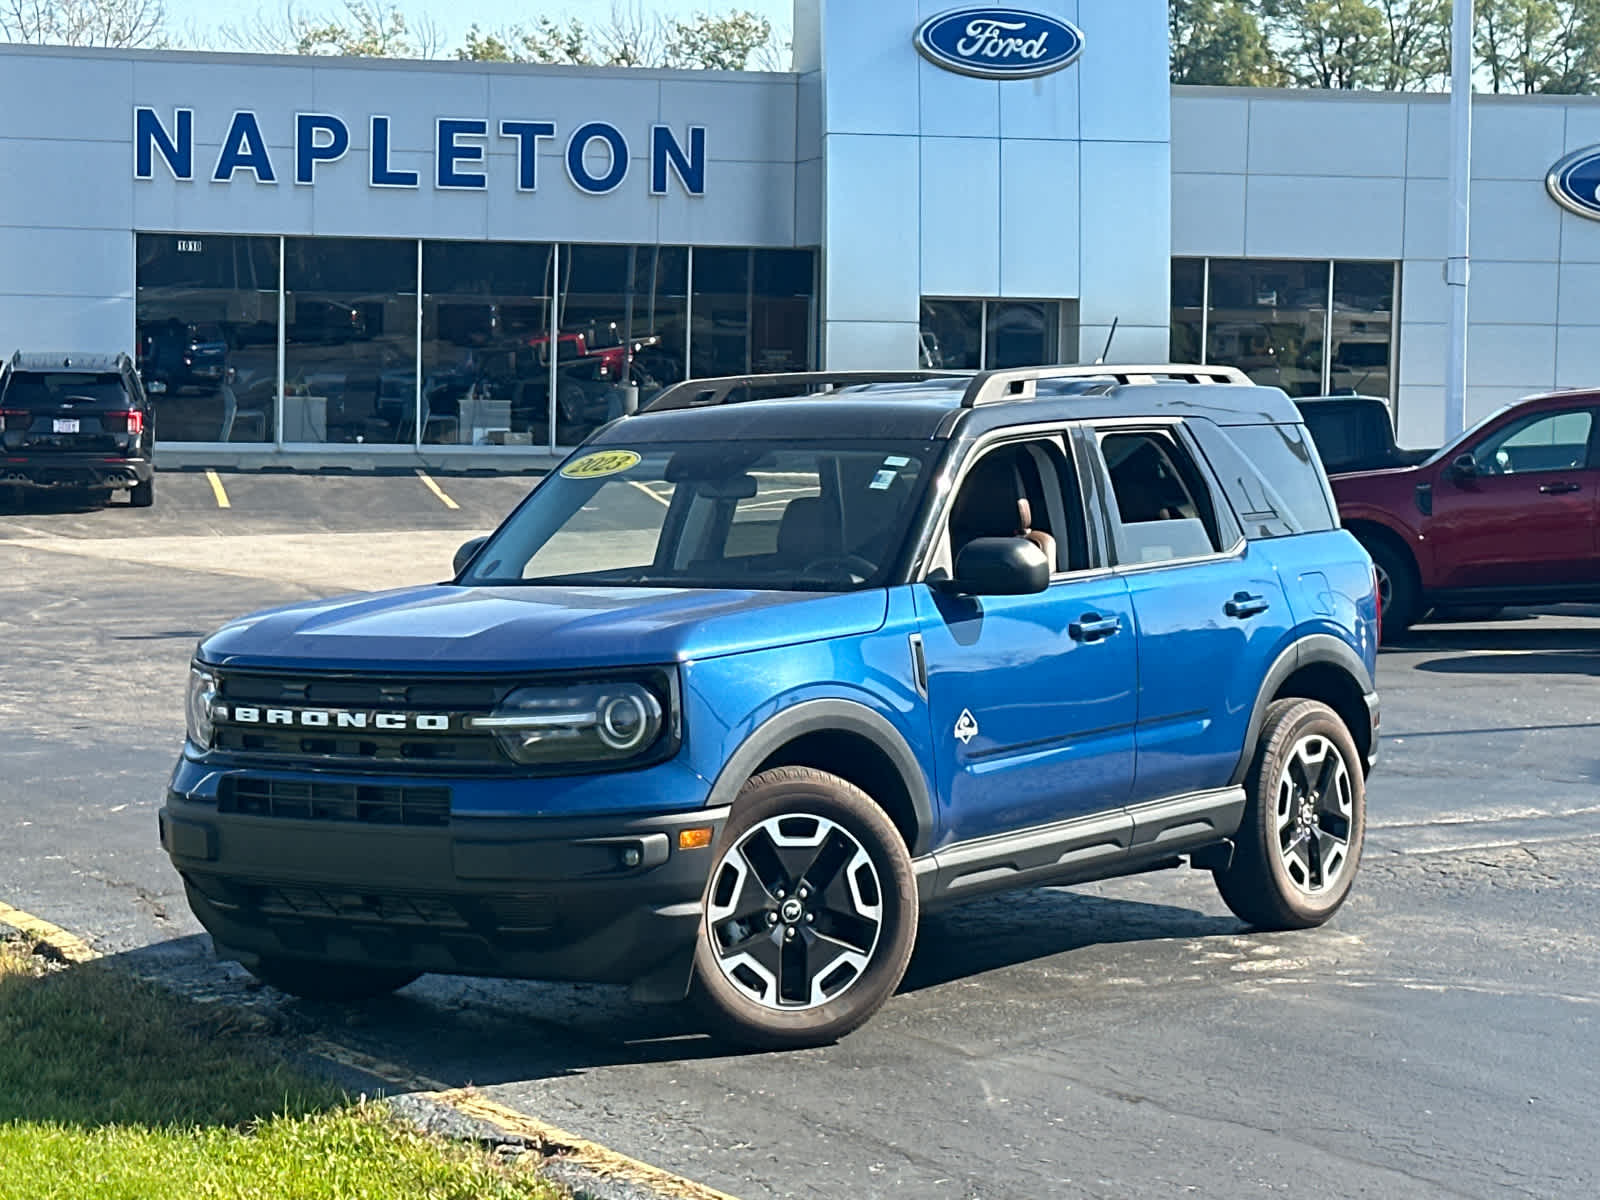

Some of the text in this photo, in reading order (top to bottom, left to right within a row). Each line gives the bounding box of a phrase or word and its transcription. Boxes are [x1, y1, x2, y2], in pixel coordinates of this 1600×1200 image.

[956, 19, 1049, 59] Ford
[133, 106, 705, 196] NAPLETON
[567, 455, 632, 473] 2023
[235, 707, 449, 730] BRONCO
